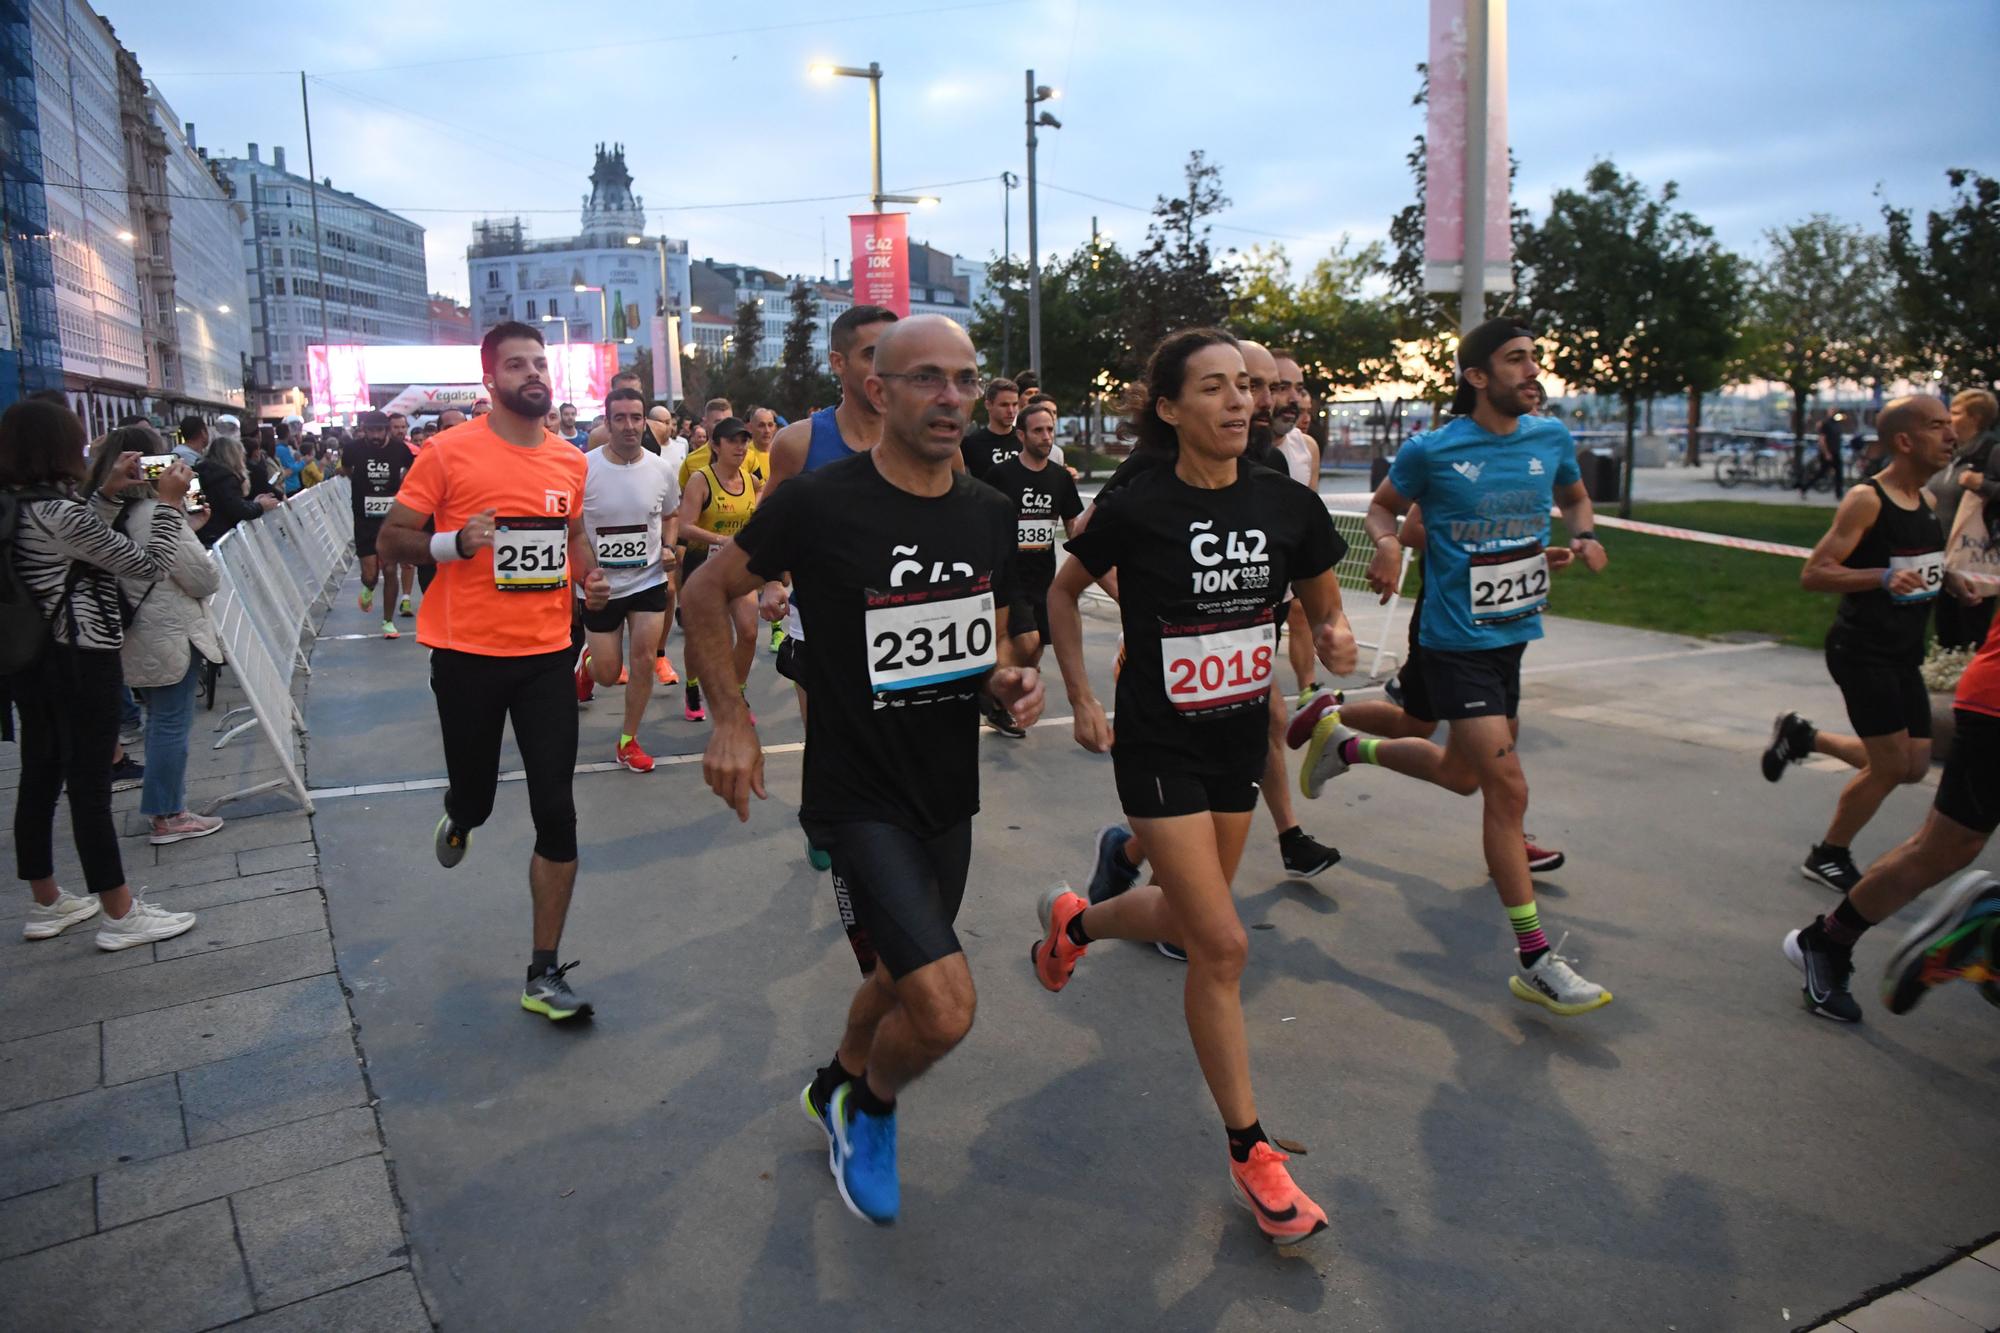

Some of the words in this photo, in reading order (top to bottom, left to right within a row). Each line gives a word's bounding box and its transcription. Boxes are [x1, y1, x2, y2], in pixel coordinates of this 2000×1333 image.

[868, 256, 891, 268] 10K
[424, 389, 476, 403] Vegalsa
[366, 502, 393, 511] 227
[1017, 528, 1053, 543] 3381
[599, 541, 647, 558] 2282
[1192, 569, 1241, 594] 10K
[1241, 565, 1270, 578] 02.10
[1242, 577, 1270, 589] 2022
[1475, 570, 1547, 606] 2212
[873, 618, 992, 672] 2310
[1170, 646, 1272, 694] 2018
